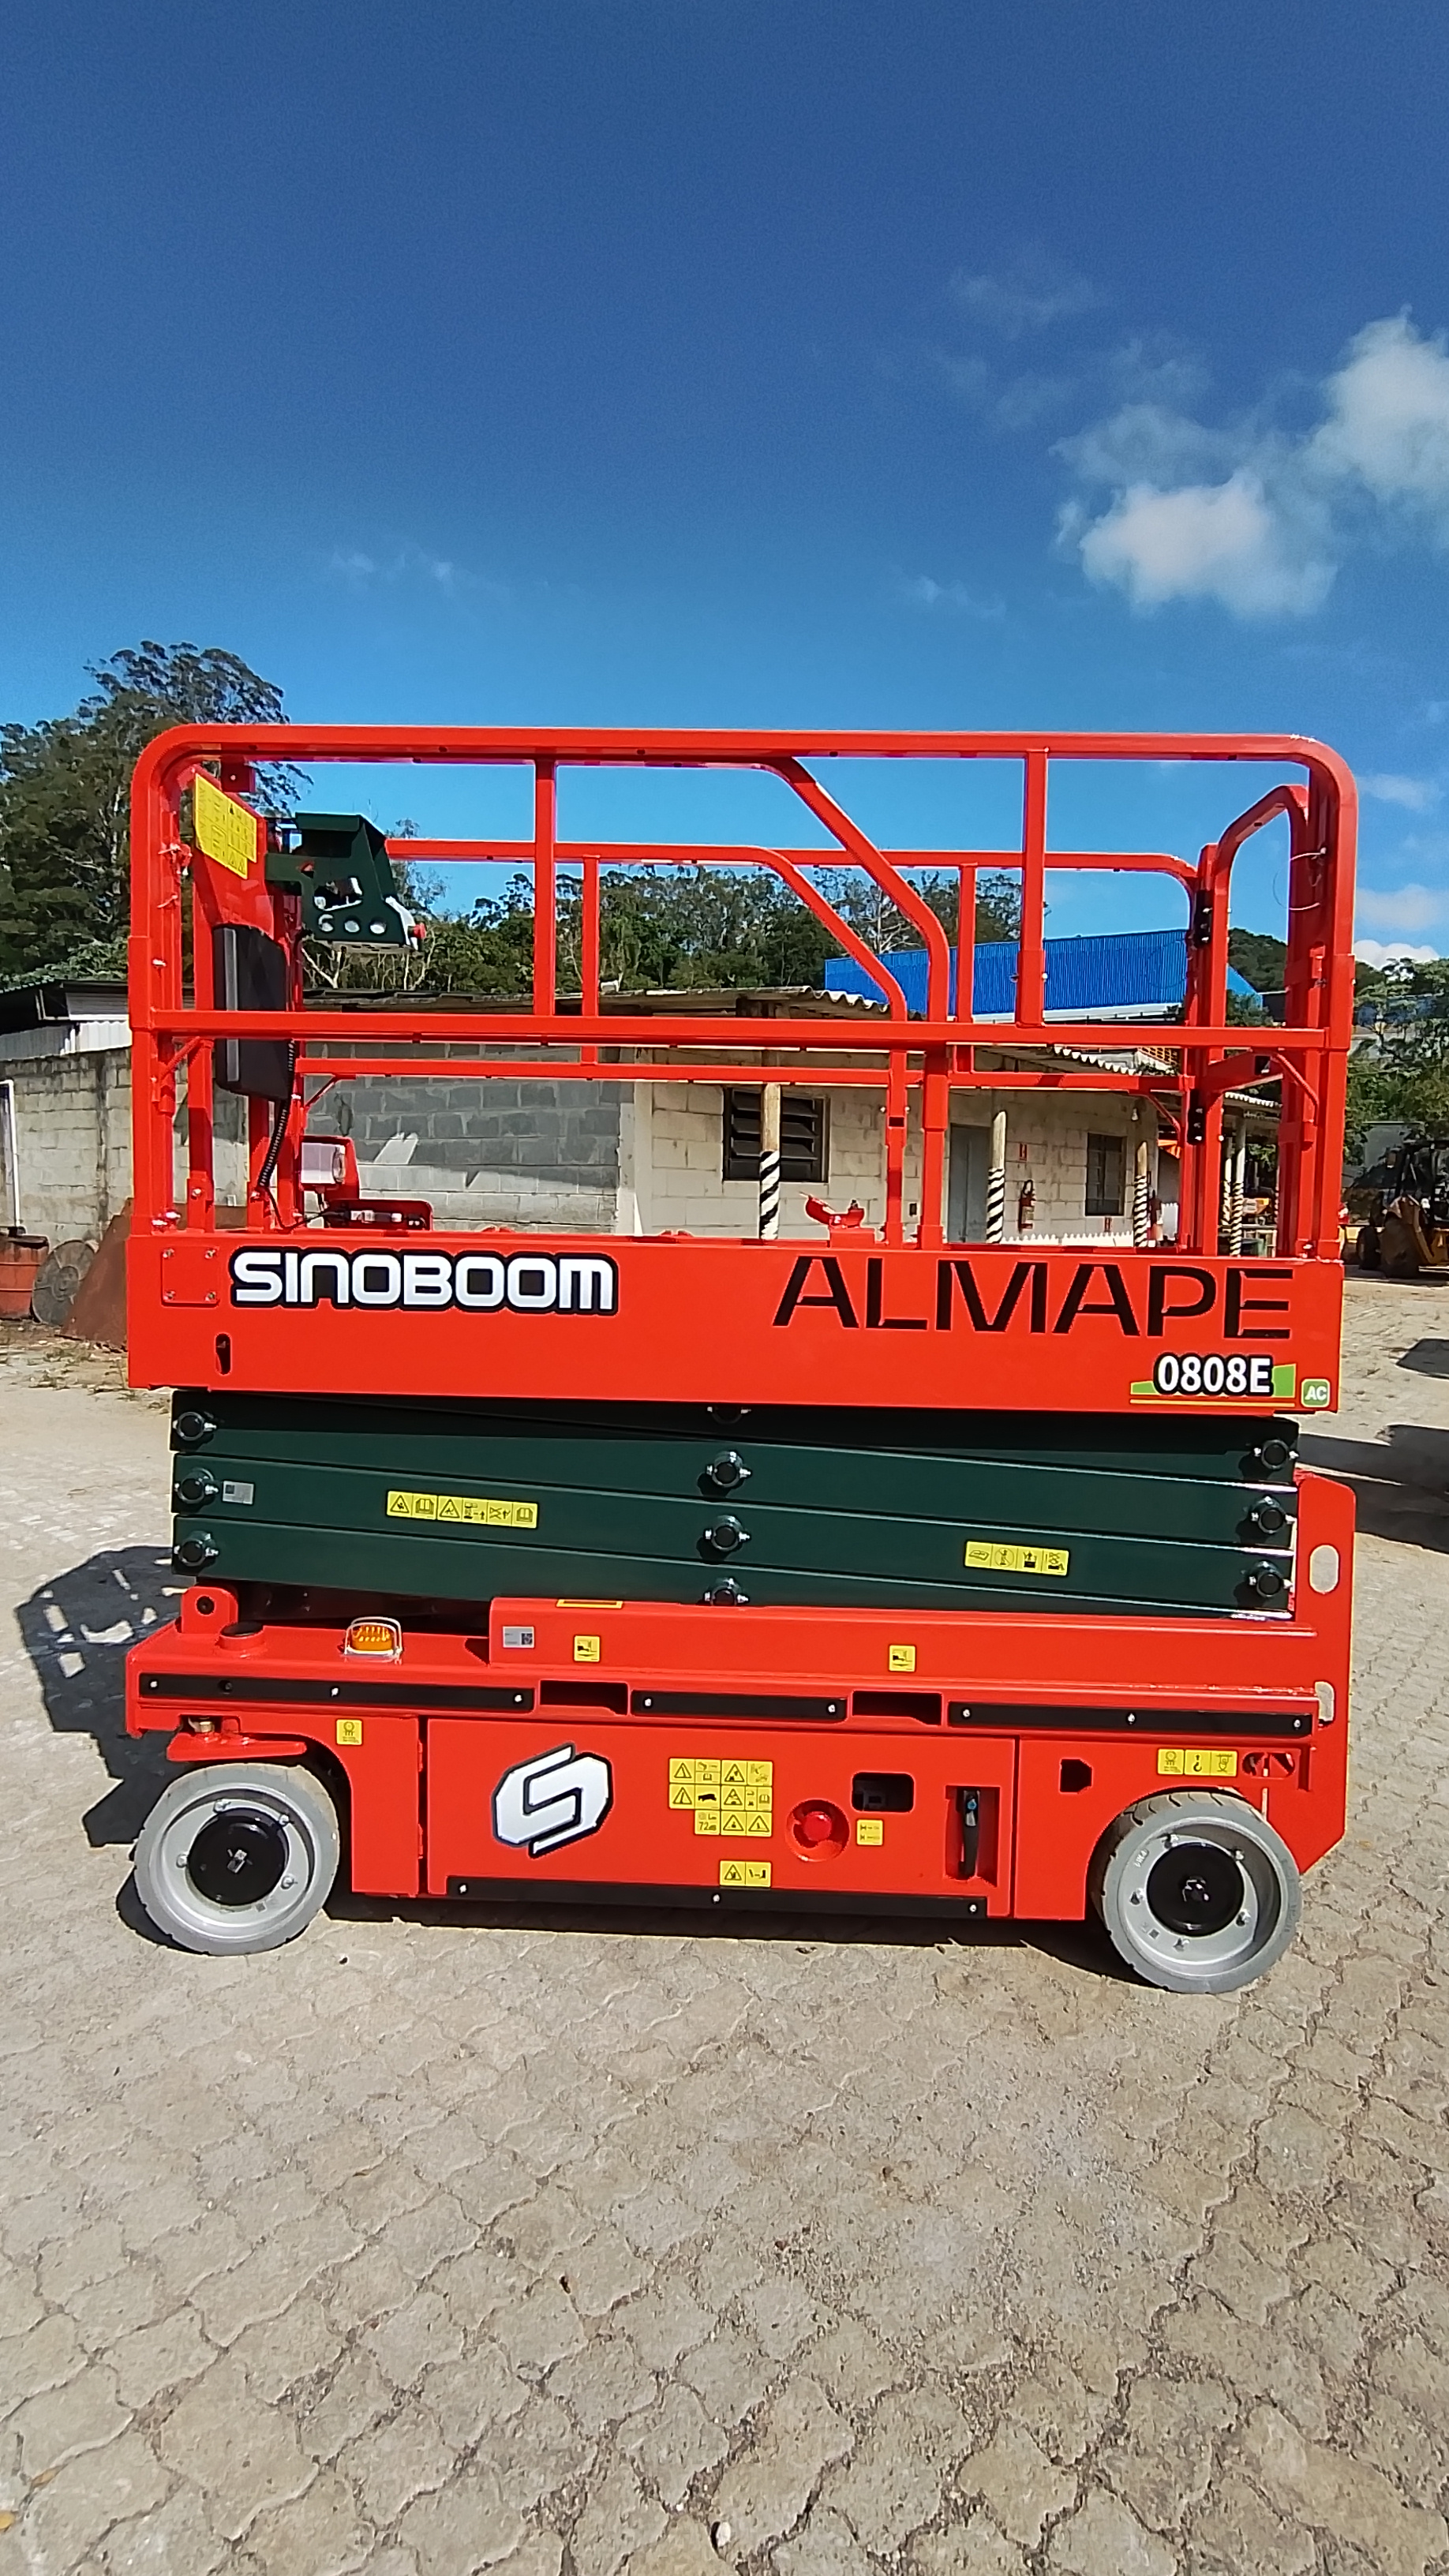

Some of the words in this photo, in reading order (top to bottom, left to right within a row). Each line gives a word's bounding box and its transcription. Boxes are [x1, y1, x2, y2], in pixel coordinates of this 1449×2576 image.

[233, 1251, 614, 1311] SINOBOOM
[772, 1255, 1294, 1339] ALMAPE
[1157, 1354, 1271, 1394] 0808E
[1304, 1385, 1327, 1401] AC
